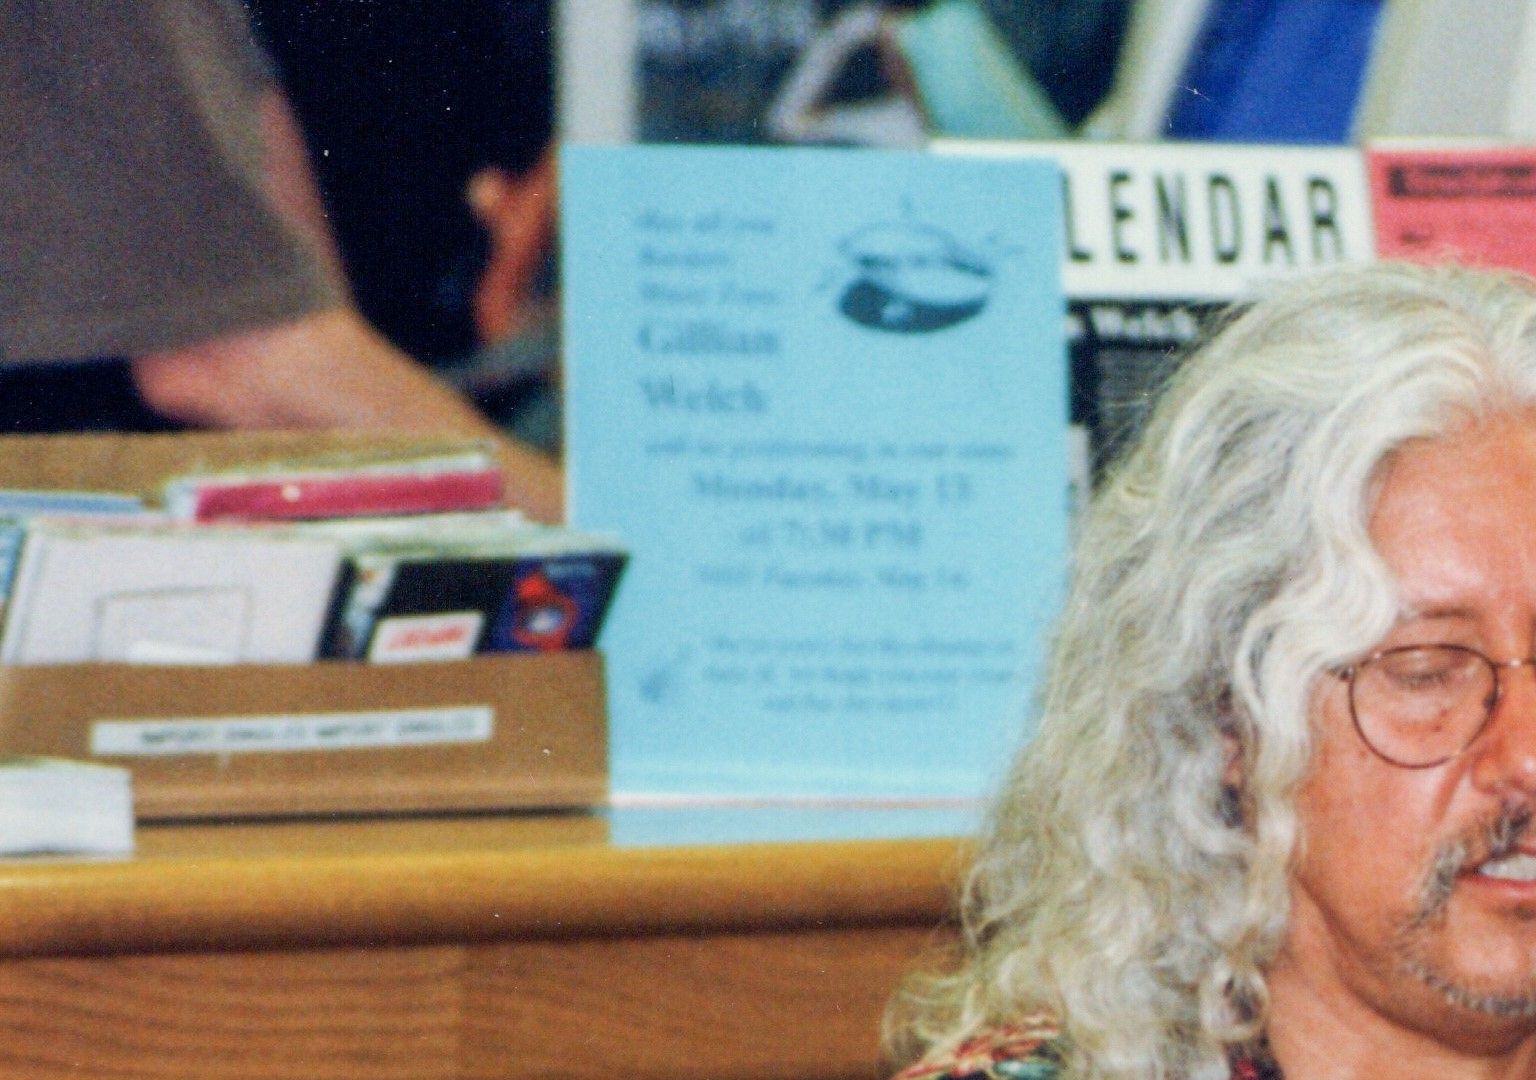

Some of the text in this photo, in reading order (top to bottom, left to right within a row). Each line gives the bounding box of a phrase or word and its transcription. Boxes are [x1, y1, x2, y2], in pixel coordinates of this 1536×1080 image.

[1062, 168, 1344, 267] LENDAR
[637, 320, 781, 354] Gillian
[638, 375, 766, 412] Welch
[694, 471, 832, 503] Monday,
[848, 472, 919, 505] May
[863, 520, 924, 548] PM
